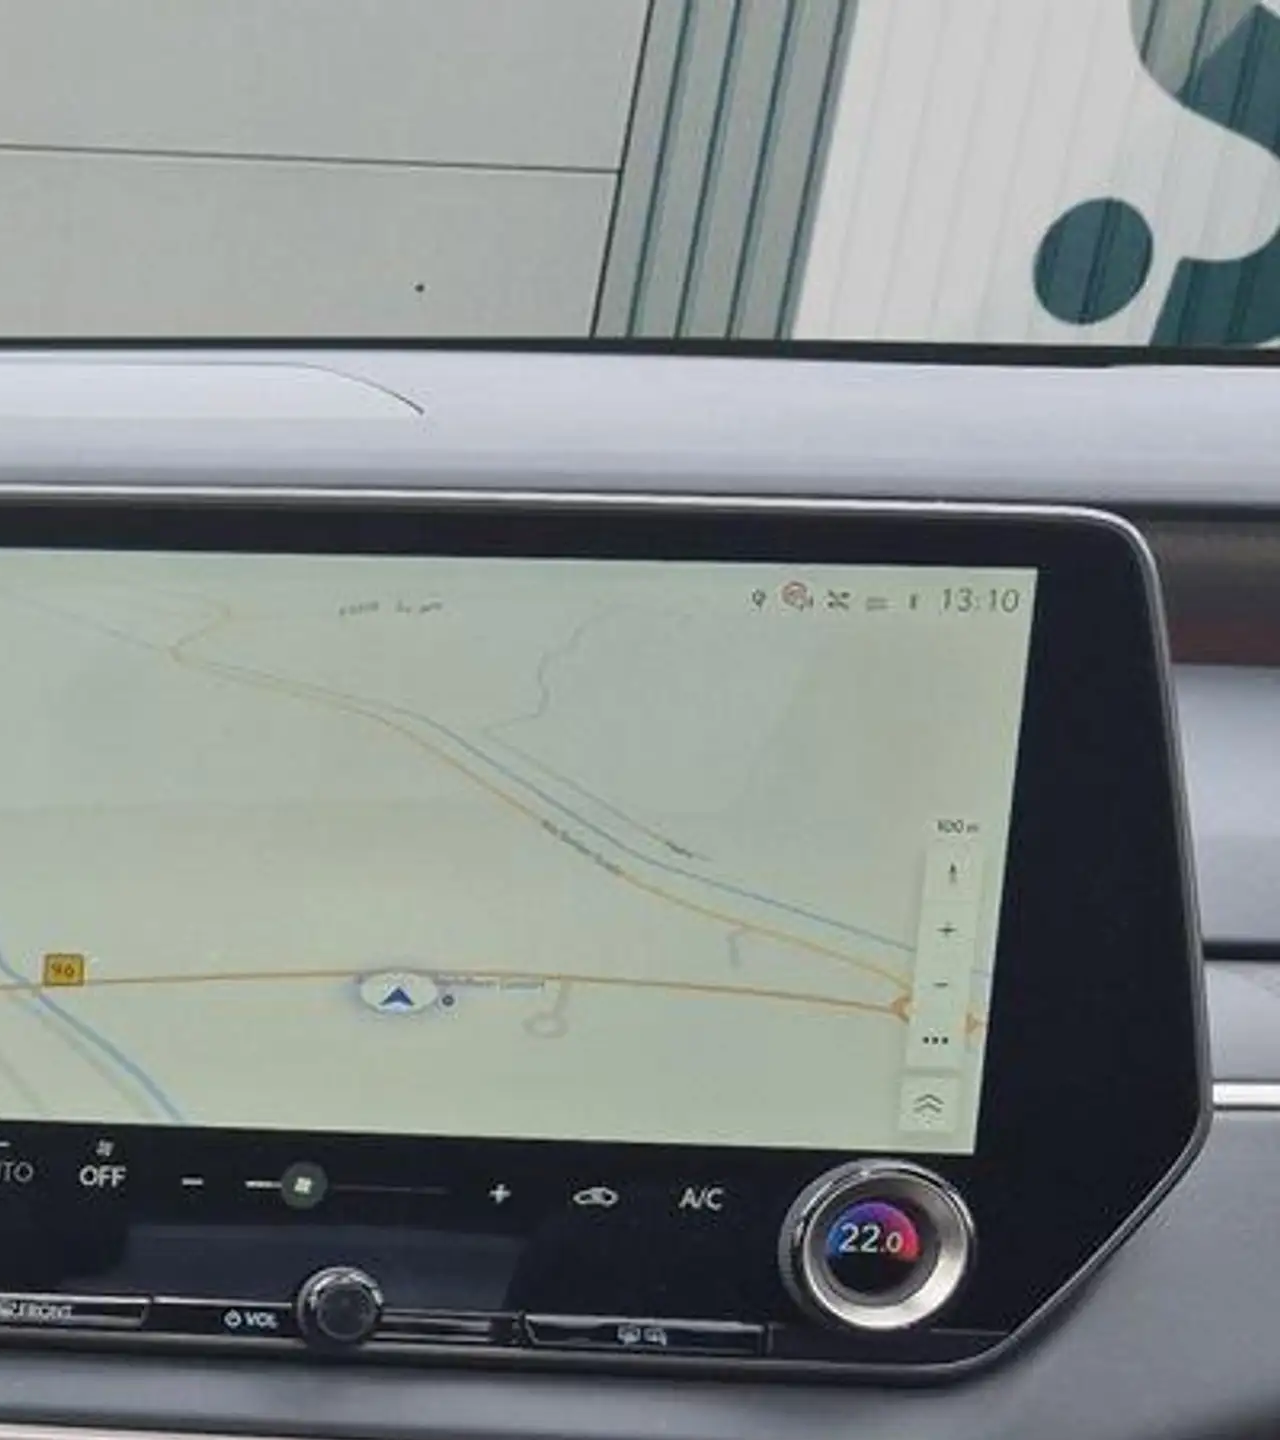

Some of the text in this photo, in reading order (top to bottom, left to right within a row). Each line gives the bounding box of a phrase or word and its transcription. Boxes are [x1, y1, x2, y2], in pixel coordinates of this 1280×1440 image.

[942, 587, 1021, 613] 13:10
[79, 1164, 127, 1188] OFF
[677, 1186, 724, 1211] A/C
[839, 1222, 904, 1254] 22.0
[244, 1311, 279, 1329] VOL
